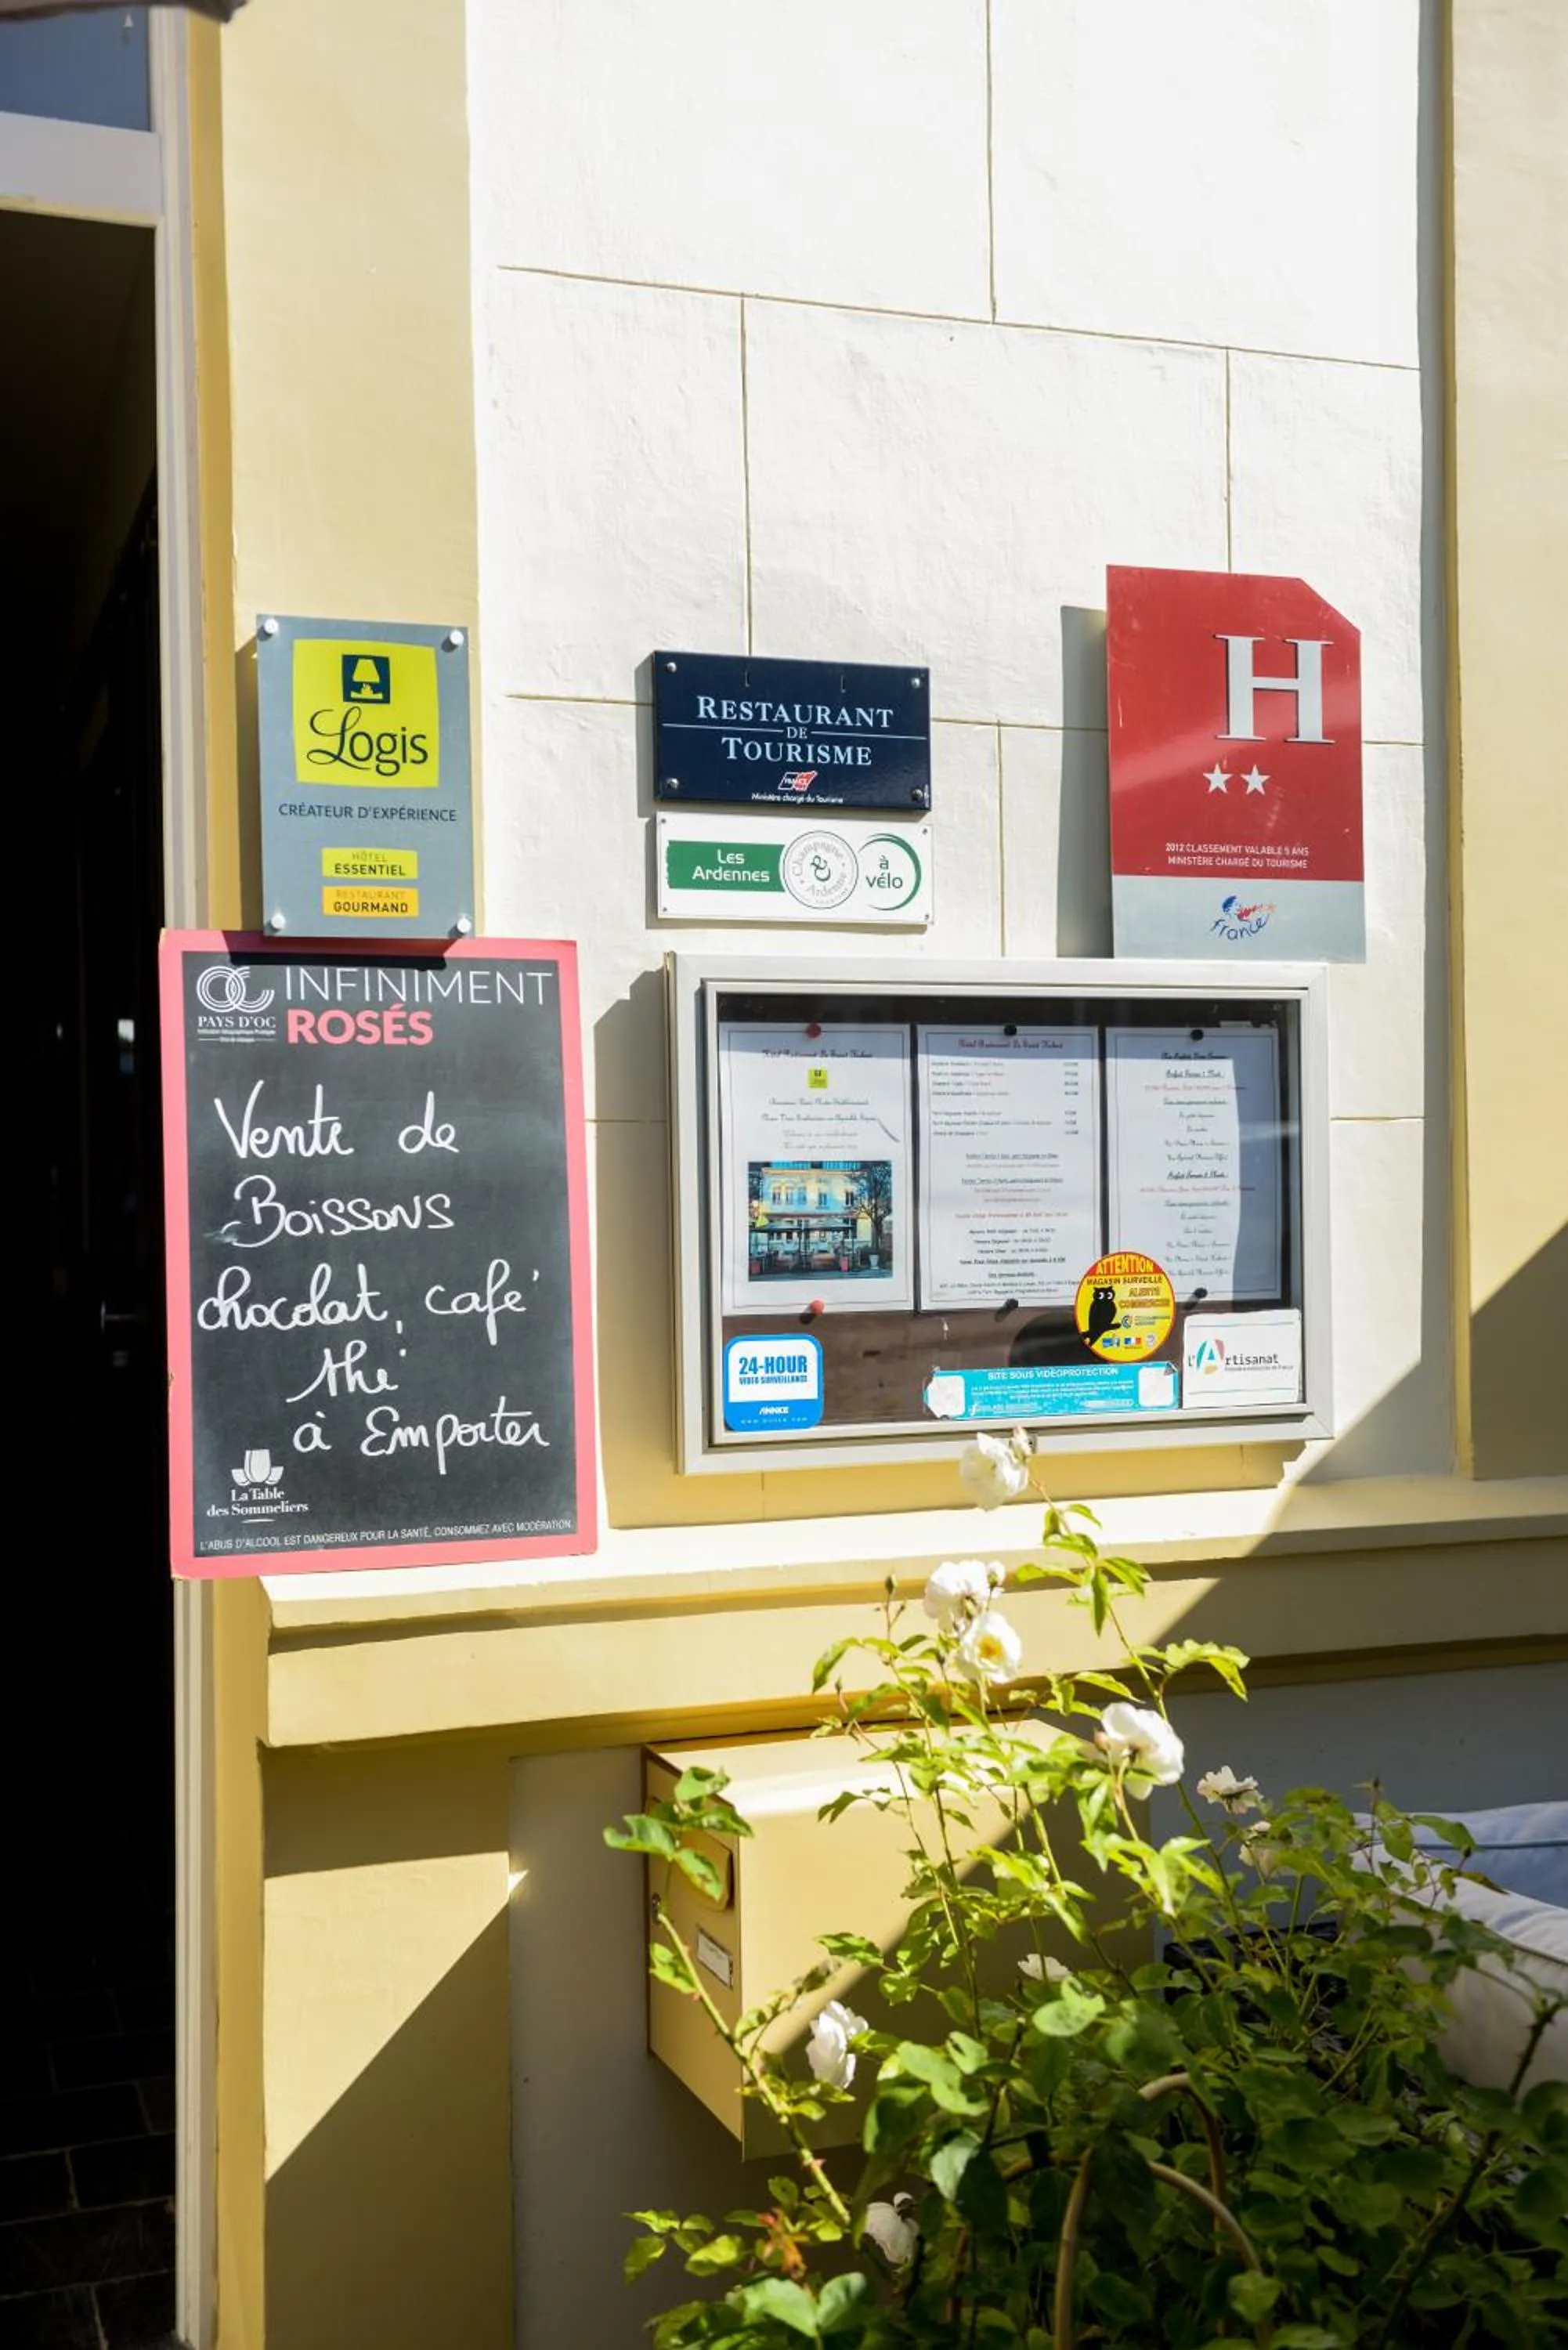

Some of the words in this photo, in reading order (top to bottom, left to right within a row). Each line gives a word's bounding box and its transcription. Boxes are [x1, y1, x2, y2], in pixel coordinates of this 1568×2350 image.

[1213, 634, 1335, 743] H
[696, 696, 894, 728] RESTAURANT
[786, 726, 808, 739] DE
[306, 706, 428, 776] Logis
[721, 737, 873, 765] TOURISME
[278, 802, 353, 819] CRÉATEUR
[358, 804, 457, 822] D'EXPÉRIENCE
[352, 850, 388, 862] HÔTEL
[1165, 843, 1184, 851] 2012
[1187, 844, 1241, 854] CLASSEMENT
[1245, 845, 1283, 855] VALABLE
[1292, 847, 1310, 856] ANS
[334, 863, 406, 876] ESSENTIEL
[880, 855, 890, 870] à
[1168, 855, 1213, 866] MINISTÈRE
[1252, 859, 1263, 867] DU
[1266, 859, 1308, 868] TOURISME
[865, 873, 903, 889] vélo
[336, 889, 406, 900] RESTAURANT
[334, 902, 408, 913] GOURMAND
[286, 966, 553, 1005] INFINIMENT
[198, 1016, 235, 1028] PAYS
[239, 1016, 276, 1028] D'OC
[287, 1003, 434, 1045] ROSÉS
[214, 1079, 355, 1159] Vente
[397, 1090, 459, 1153] de
[1097, 1253, 1154, 1274] ATTENTION
[1086, 1277, 1120, 1285] MAGASIN
[425, 1259, 540, 1346] café
[739, 1355, 807, 1375] 24-HOUR
[988, 1372, 1007, 1381] SITE
[1010, 1370, 1035, 1379] SOUS
[293, 1411, 331, 1452] à
[360, 1395, 550, 1475] Emporter
[231, 1489, 248, 1502] La
[249, 1487, 285, 1500] Table
[207, 1505, 229, 1517] des
[231, 1501, 309, 1516] Sommeliers
[201, 1538, 233, 1550] L'ABUS
[236, 1536, 280, 1549] D'ALCOOL
[284, 1535, 302, 1546] EST
[304, 1531, 357, 1544] DANGEREUX
[360, 1530, 385, 1541] POUR
[388, 1530, 399, 1539] LA
[434, 1524, 490, 1537] CONSOMMEZ
[492, 1522, 515, 1534] AVEC
